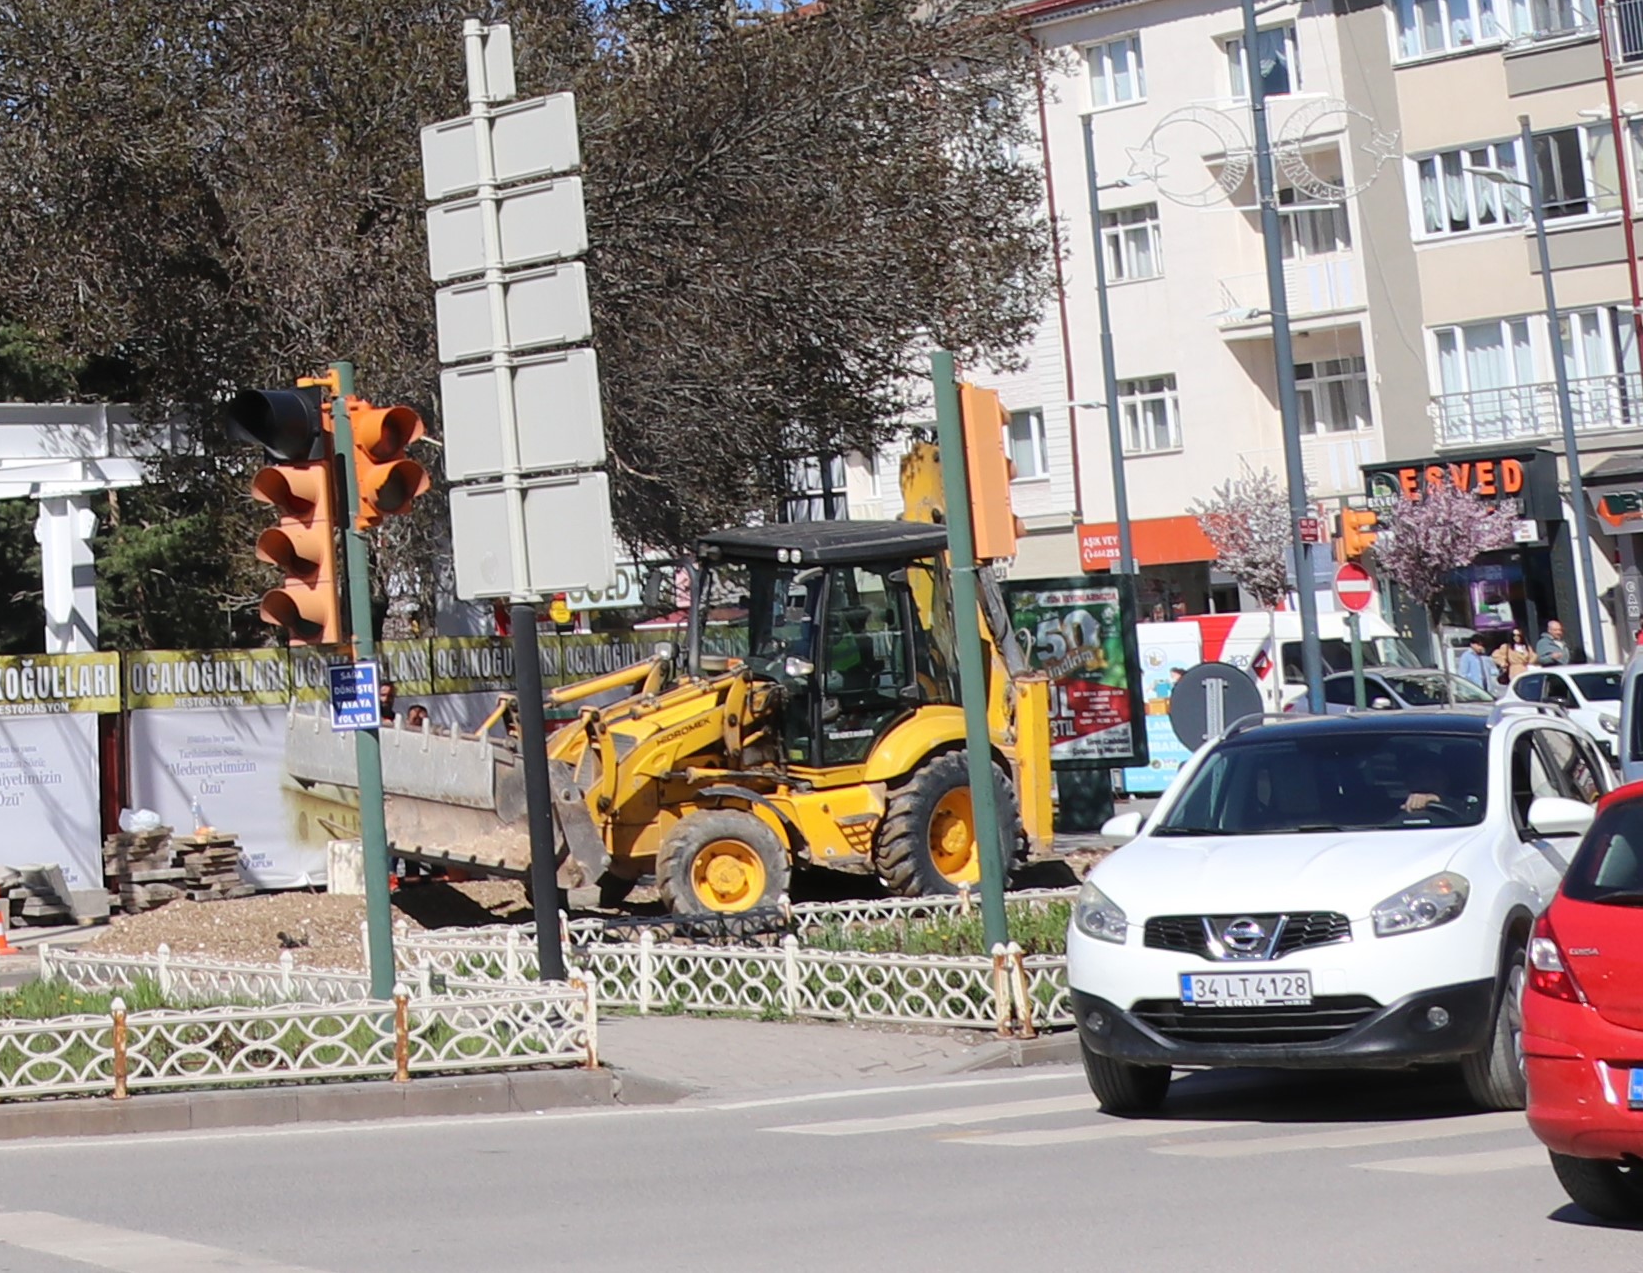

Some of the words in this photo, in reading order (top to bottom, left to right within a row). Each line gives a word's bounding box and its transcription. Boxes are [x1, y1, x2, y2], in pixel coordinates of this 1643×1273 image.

[132, 653, 285, 694] OCAKOĞULLARI
[338, 715, 354, 724] YOL
[355, 713, 373, 722] VER
[1194, 978, 1219, 998] 34
[1225, 978, 1250, 998] LT
[1255, 976, 1308, 997] 4128
